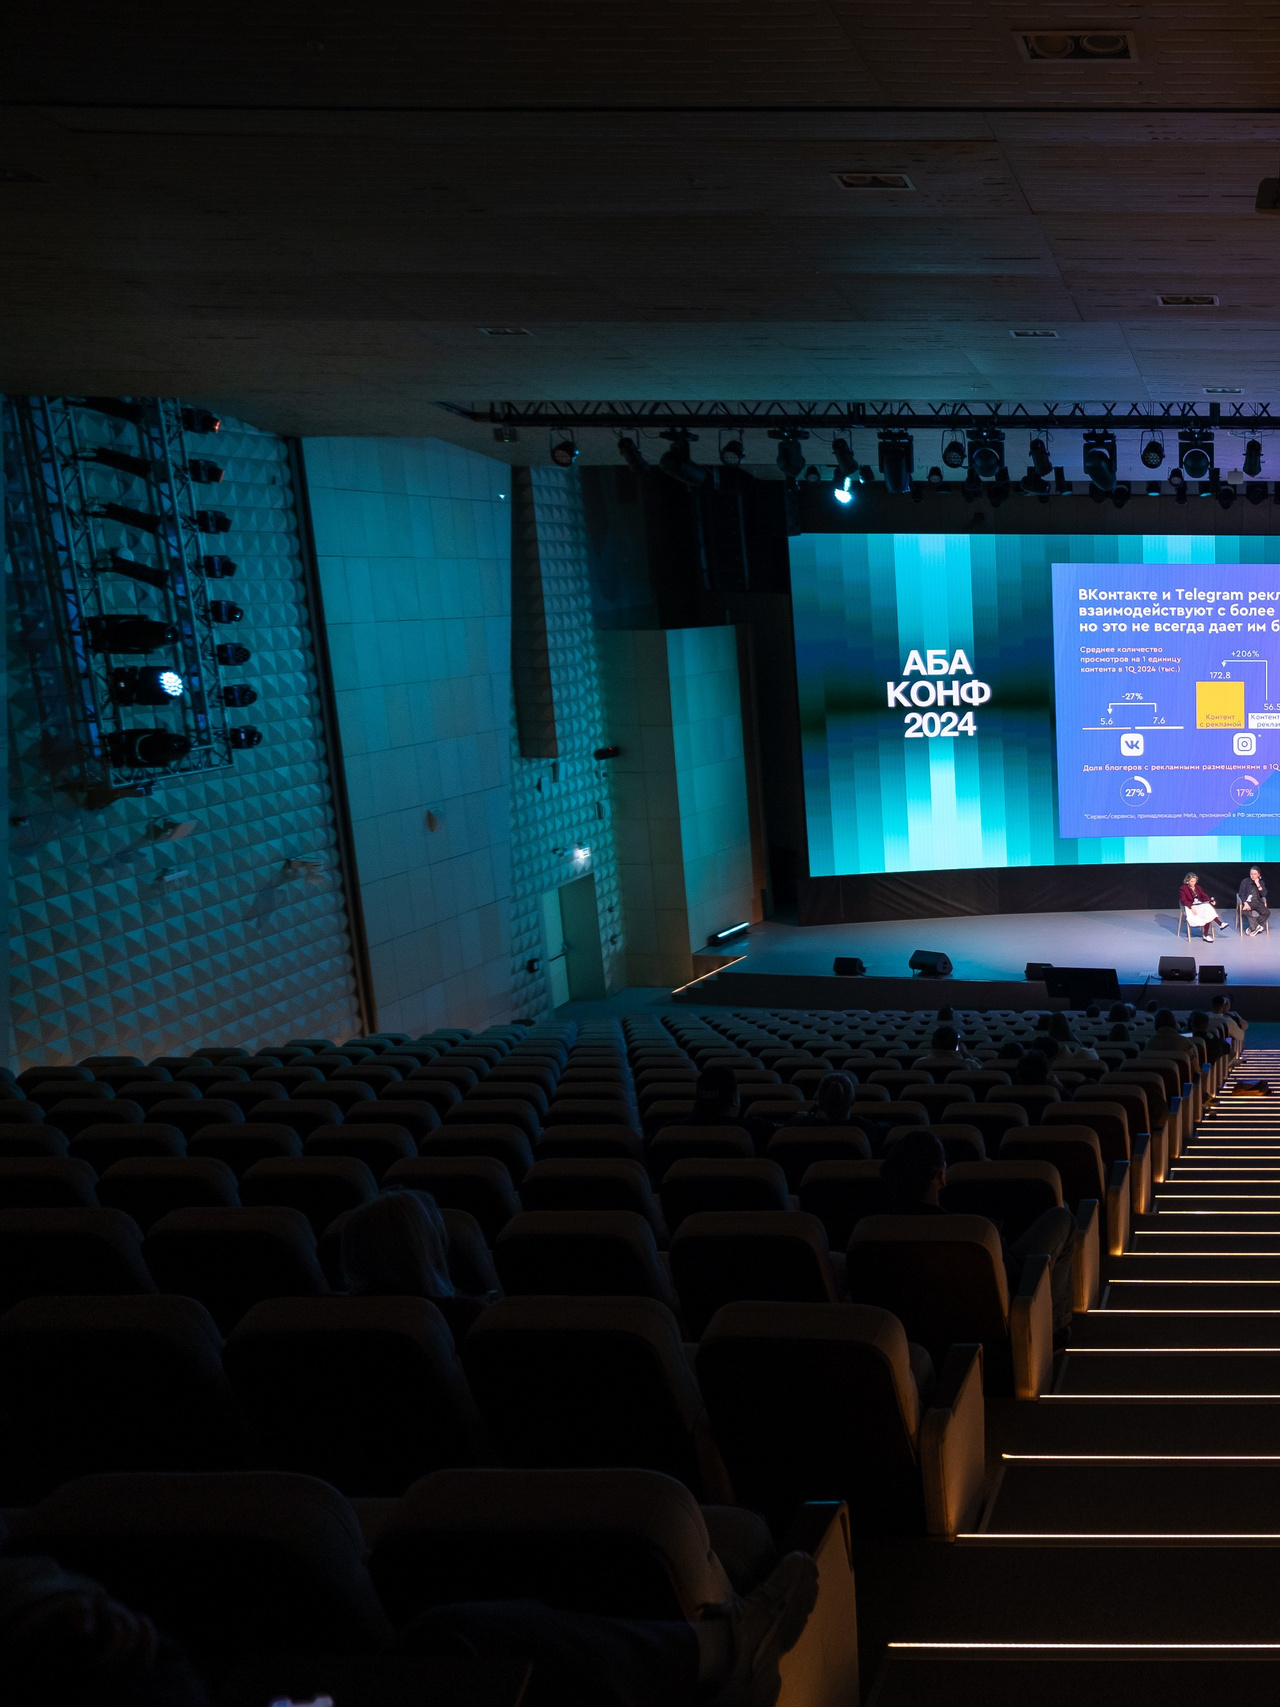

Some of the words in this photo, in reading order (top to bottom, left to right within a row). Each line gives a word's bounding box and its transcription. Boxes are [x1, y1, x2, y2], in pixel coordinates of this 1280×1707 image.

[1078, 589, 1157, 600] ВКонтакте
[1163, 592, 1170, 600] и
[1176, 588, 1243, 603] Telegram
[1080, 604, 1213, 618] взаимодействуют
[1218, 607, 1225, 616] с
[1230, 604, 1274, 616] более
[1080, 622, 1097, 632] но
[1102, 622, 1127, 632] это
[1132, 622, 1149, 632] не
[1154, 622, 1204, 634] всегда
[1209, 622, 1243, 634] дает
[1248, 622, 1266, 632] им
[903, 649, 973, 675] АБА
[886, 680, 992, 707] КОНФ
[904, 711, 977, 737] 2024
[1105, 764, 1142, 772] блогеров
